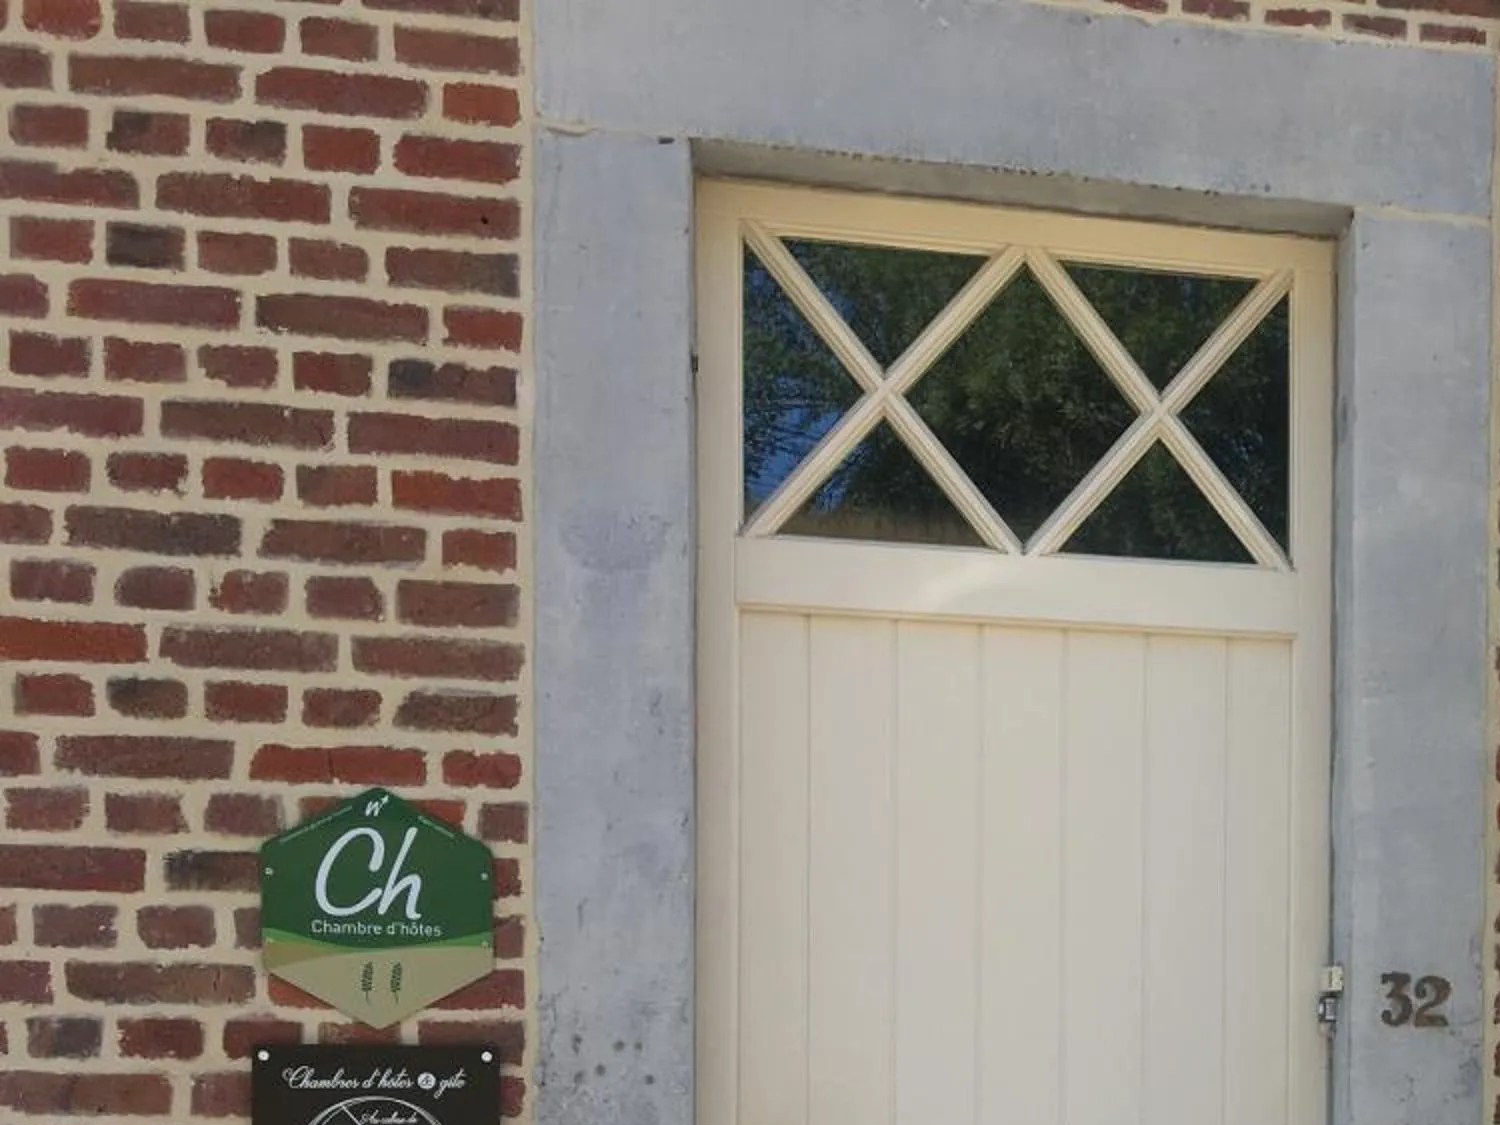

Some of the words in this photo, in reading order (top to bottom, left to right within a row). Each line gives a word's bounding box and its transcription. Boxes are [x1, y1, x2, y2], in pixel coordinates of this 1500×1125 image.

[315, 826, 423, 920] Ch
[310, 919, 383, 935] Chambre
[386, 921, 442, 937] d'hôtes
[1381, 970, 1452, 1028] 32
[281, 1065, 360, 1089] Chambres
